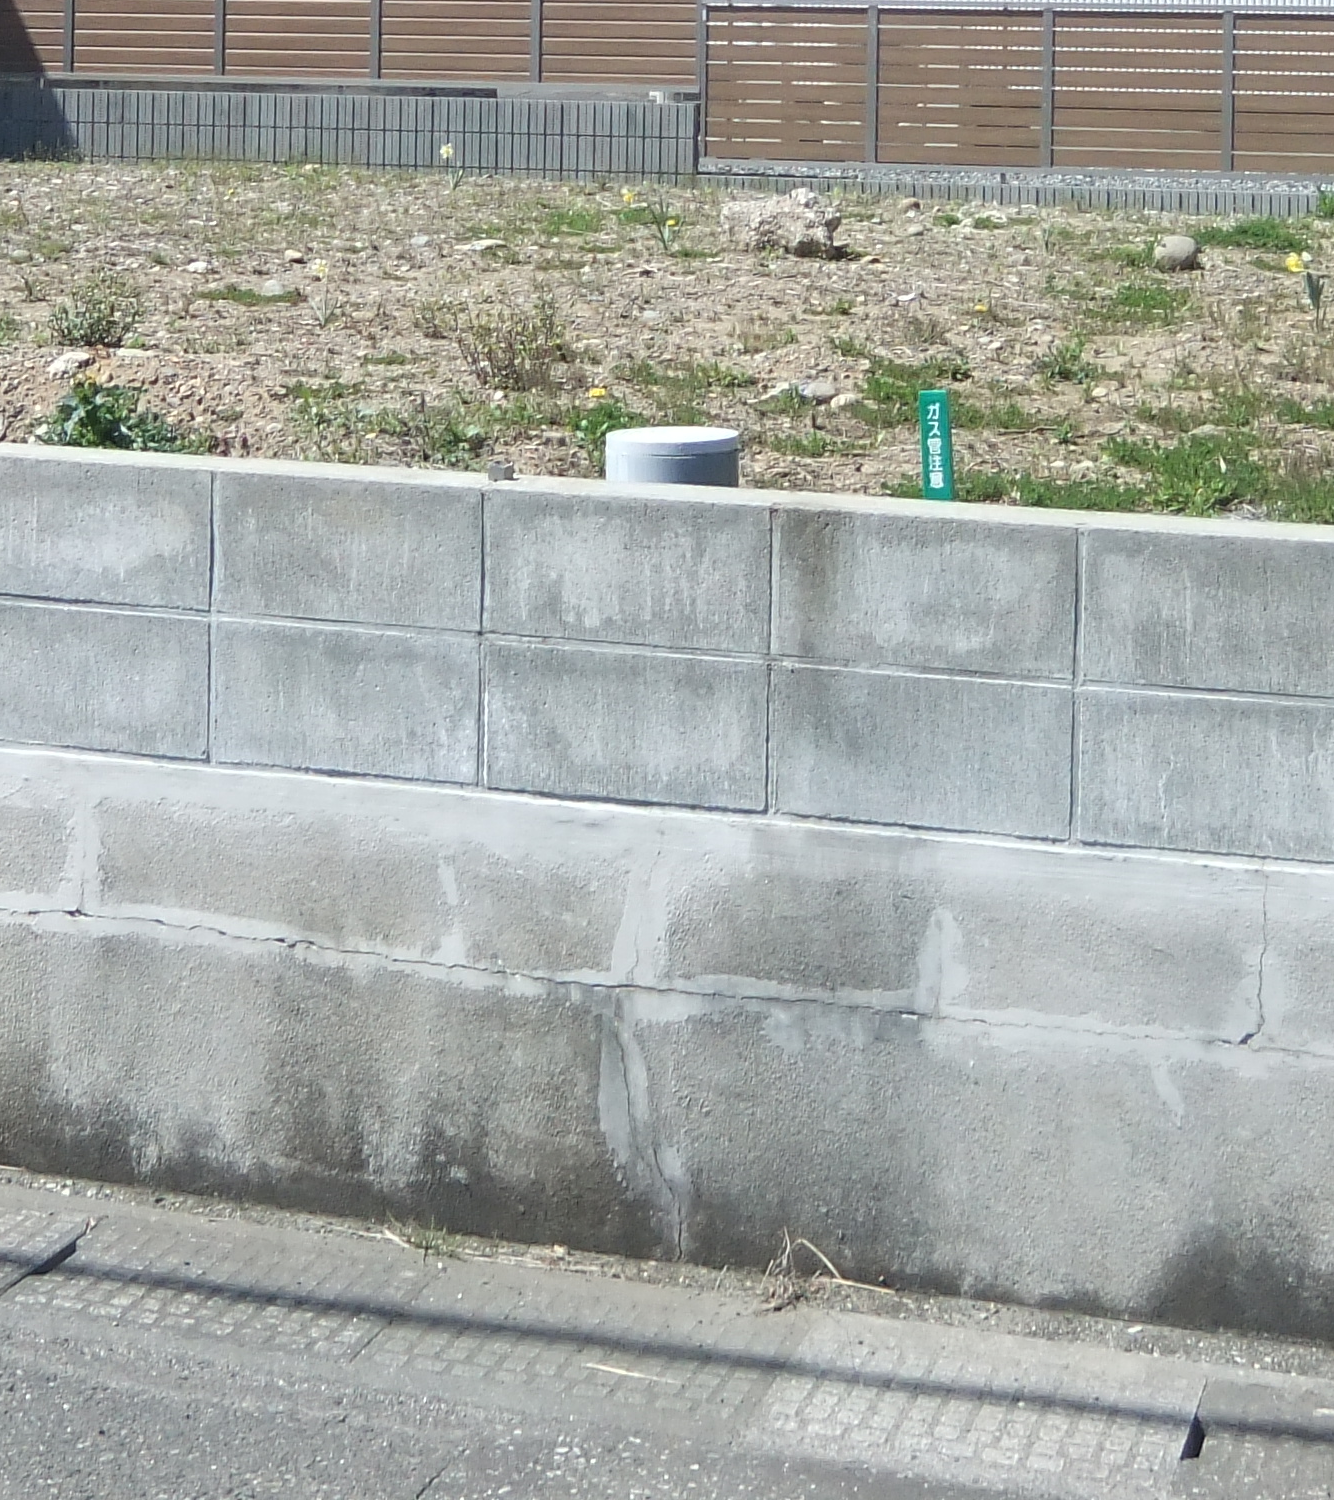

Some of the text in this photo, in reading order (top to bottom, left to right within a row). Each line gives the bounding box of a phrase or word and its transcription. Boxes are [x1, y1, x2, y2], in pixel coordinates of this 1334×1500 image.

[927, 402, 944, 489] ガス管注意
